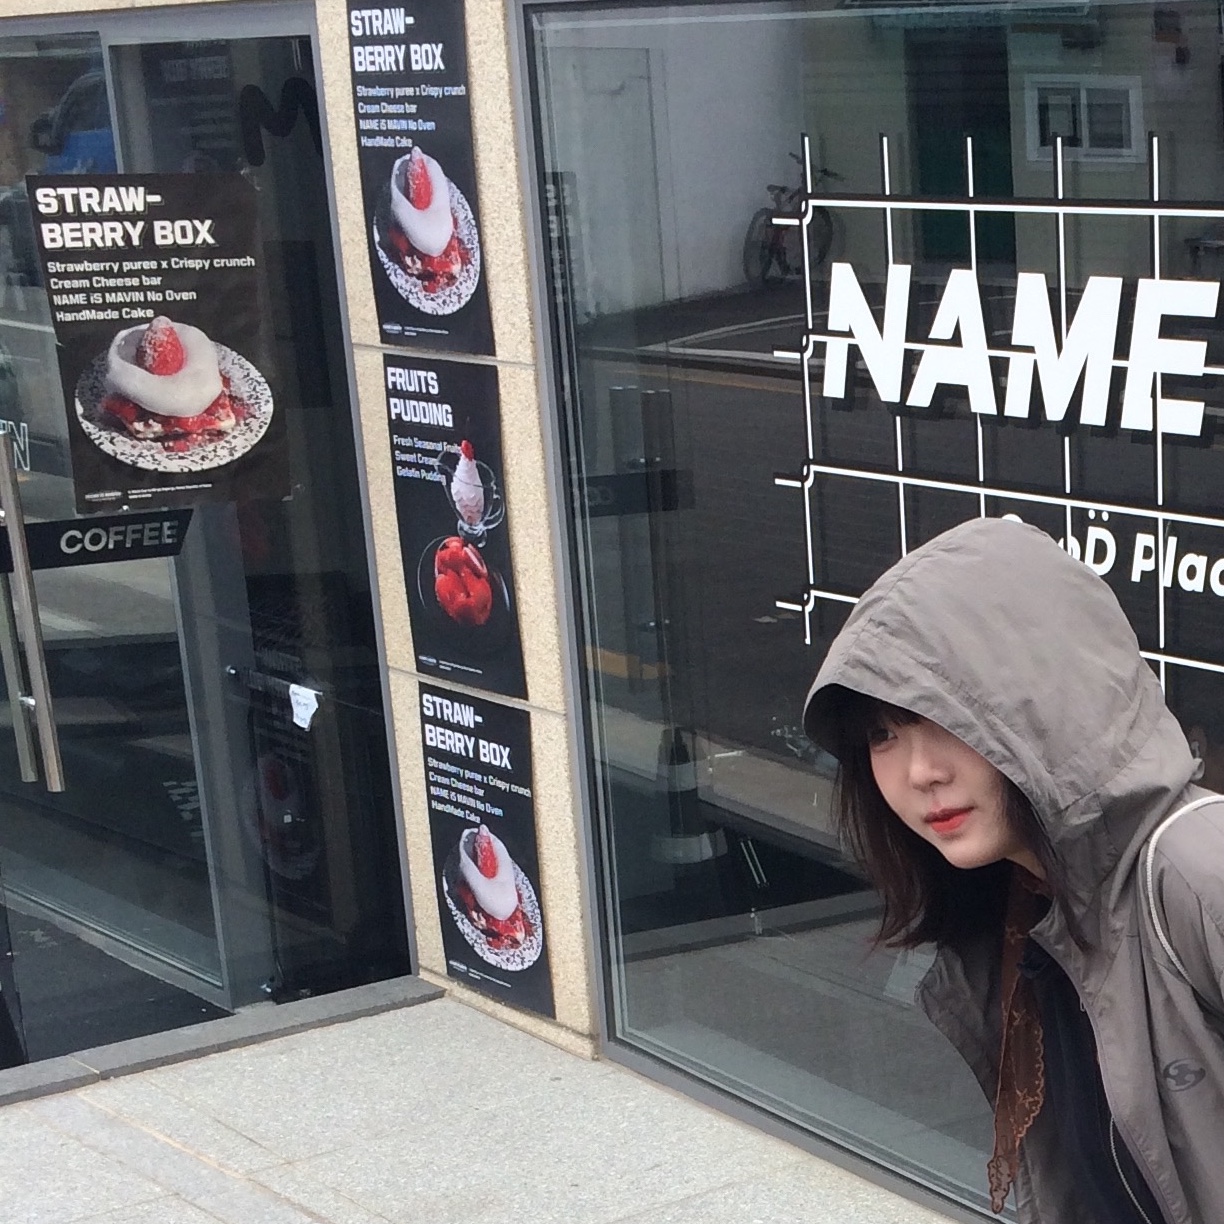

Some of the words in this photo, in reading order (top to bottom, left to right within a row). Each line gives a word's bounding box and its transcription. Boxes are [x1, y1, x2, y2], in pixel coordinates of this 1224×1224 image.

[351, 8, 415, 36] STRAW-
[353, 45, 406, 72] BERRY
[410, 43, 445, 71] BOX
[36, 186, 163, 214] STRAW-
[41, 221, 145, 249] BERRY
[154, 219, 217, 247] BOX
[47, 261, 119, 273] Strawberry
[123, 260, 158, 271] puree
[161, 260, 169, 269] x
[171, 257, 210, 270] Crispy
[213, 256, 255, 267] crunch
[50, 277, 90, 289] Cream
[93, 275, 140, 287] Cheese
[142, 275, 162, 285] bar
[53, 293, 87, 305] NAME
[105, 292, 144, 303] MAVIN
[147, 291, 163, 301] No
[165, 290, 197, 300] Oven
[56, 308, 119, 322] HandMade
[122, 307, 154, 318] Cake
[822, 262, 1221, 437] NAME
[387, 366, 439, 395] FRUITS
[389, 398, 453, 428] PUDDING
[61, 520, 179, 554] COFFEE
[423, 693, 483, 729] STRAW-
[425, 723, 475, 759] BERRY
[479, 739, 512, 770] BOX
